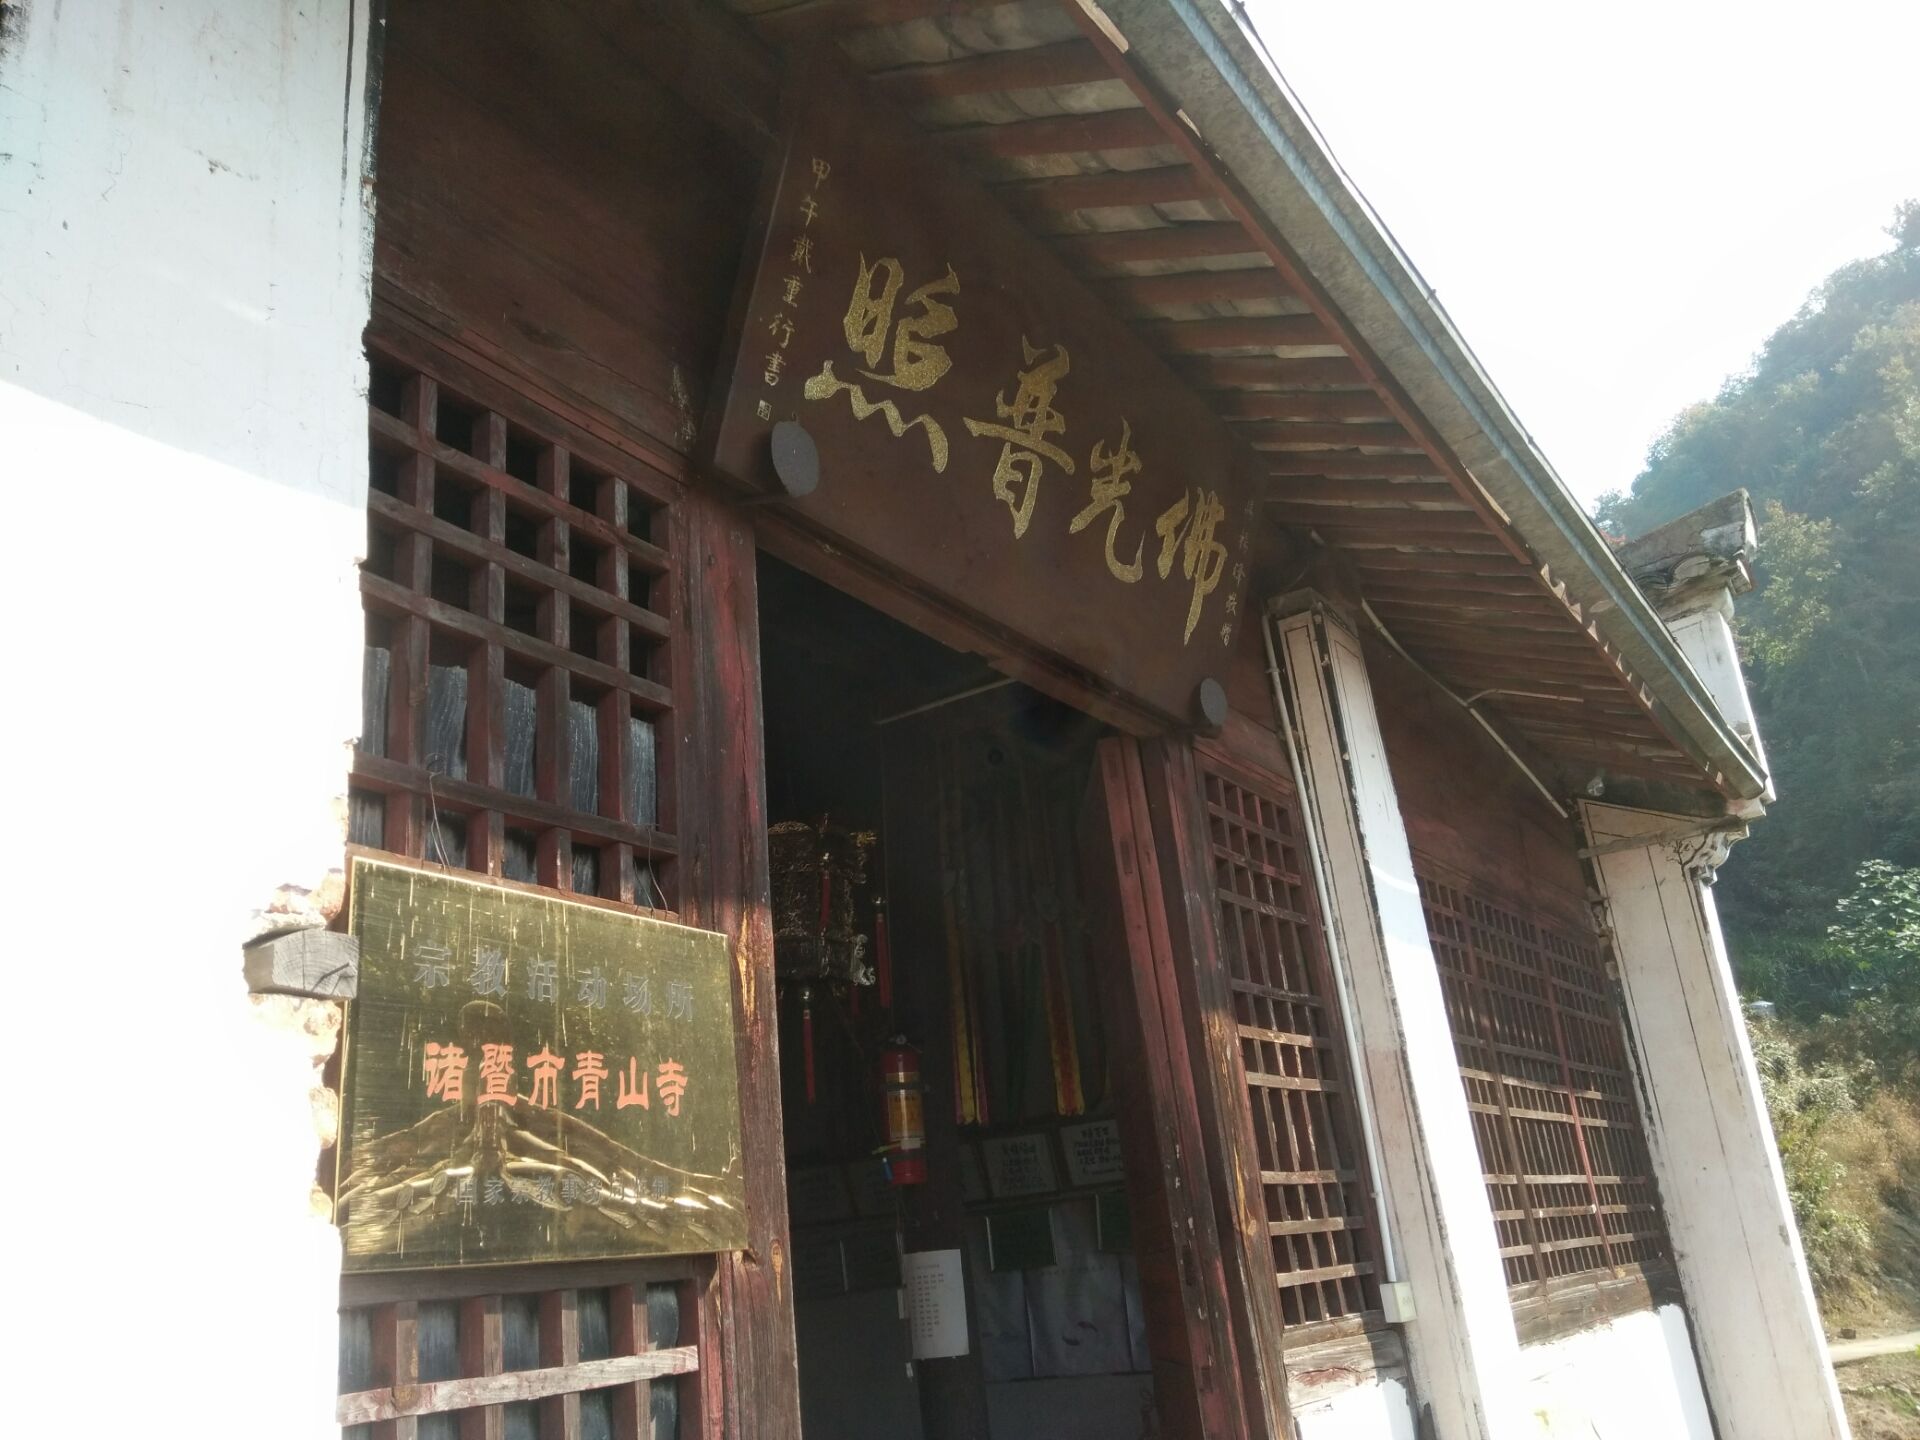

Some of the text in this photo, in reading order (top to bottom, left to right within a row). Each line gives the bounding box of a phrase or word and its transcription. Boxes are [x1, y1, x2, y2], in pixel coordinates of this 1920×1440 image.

[413, 944, 694, 1021] 宗教活动场所
[423, 1042, 688, 1117] 诸暨市青山寺
